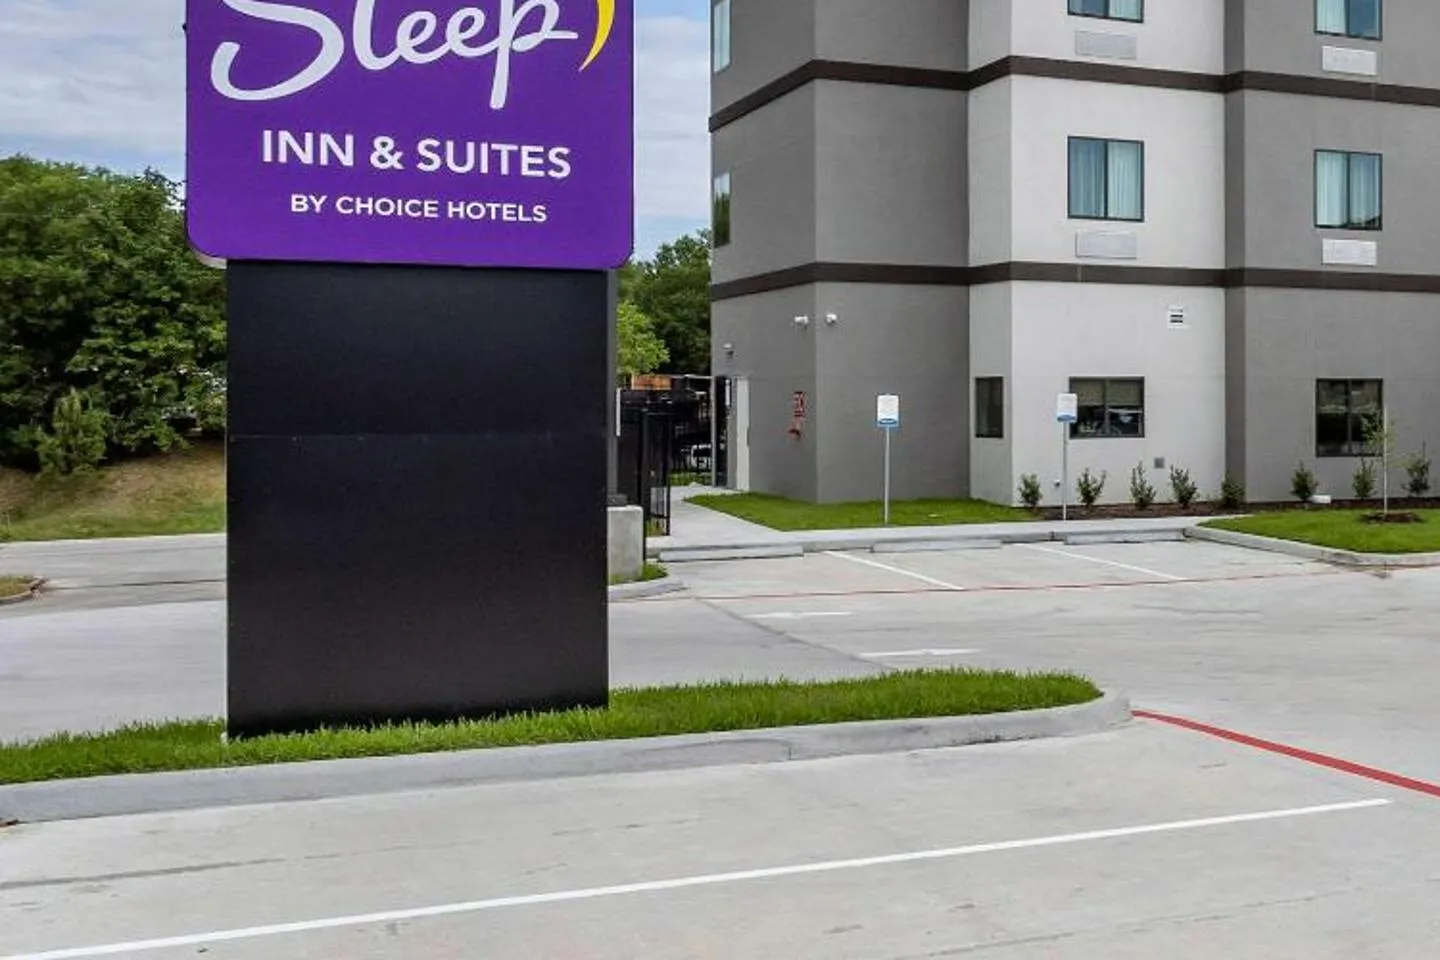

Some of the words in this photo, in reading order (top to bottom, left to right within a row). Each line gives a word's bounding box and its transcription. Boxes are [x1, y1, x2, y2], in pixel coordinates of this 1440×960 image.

[262, 130, 355, 167] INN
[369, 135, 404, 171] &
[416, 139, 572, 179] SUITES
[290, 194, 328, 214] BY
[335, 196, 439, 219] CHOICE
[446, 201, 548, 223] HOTELS
